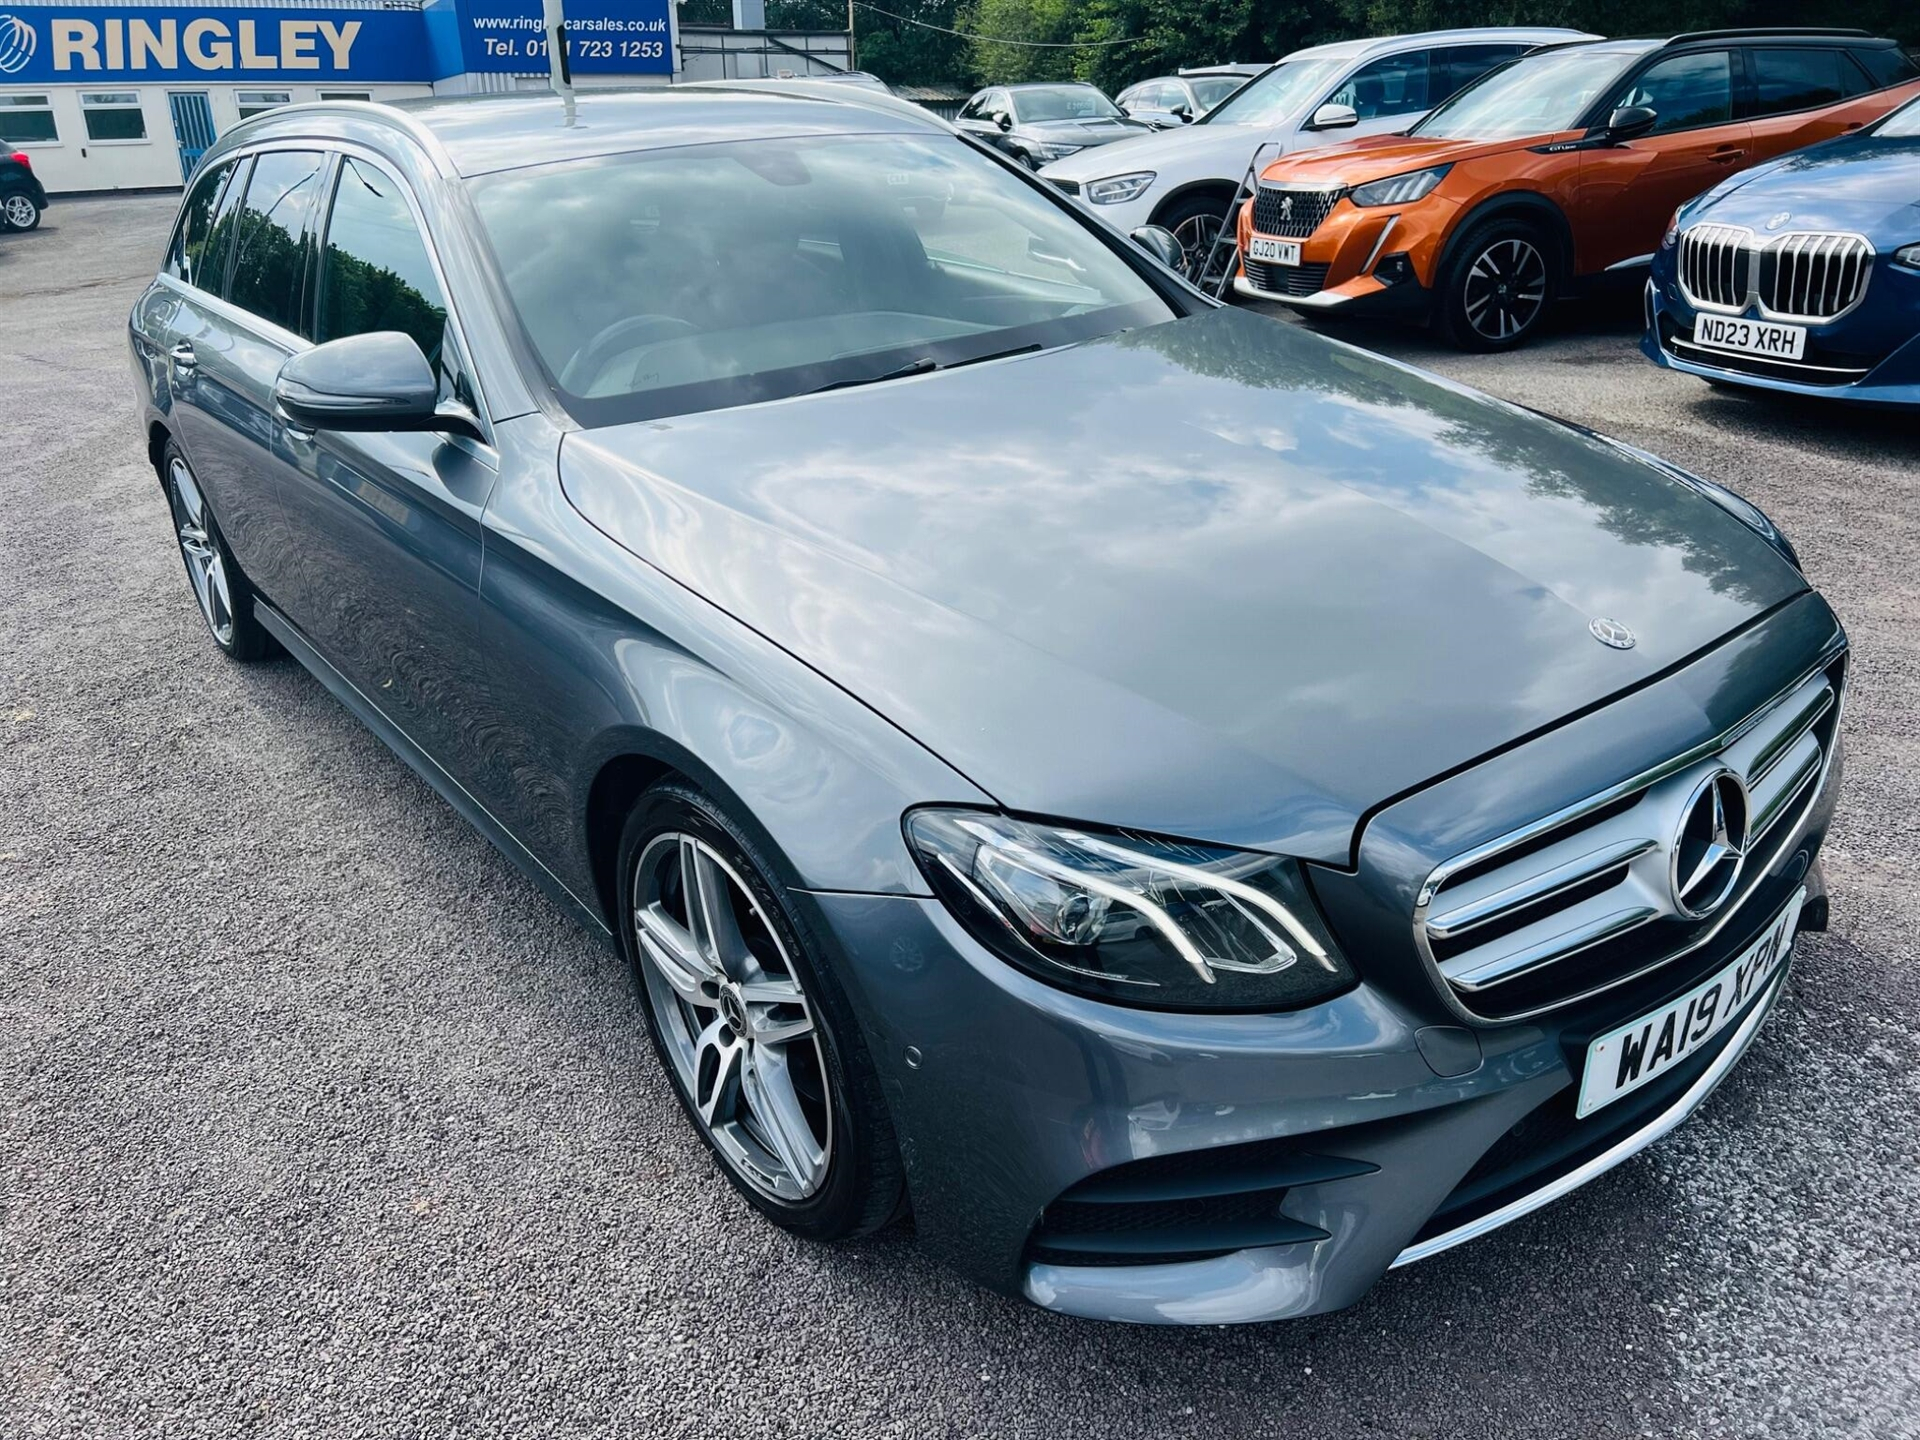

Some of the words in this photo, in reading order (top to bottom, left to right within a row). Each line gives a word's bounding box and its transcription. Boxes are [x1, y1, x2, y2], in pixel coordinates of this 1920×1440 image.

[51, 18, 362, 71] RINGLEY
[484, 39, 519, 56] Tel.
[526, 39, 570, 57] 011
[579, 40, 612, 58] 723
[621, 40, 663, 58] 1253
[1253, 240, 1275, 258] GJ20
[1701, 319, 1750, 346] ND23
[1754, 326, 1796, 354] XRH
[1615, 983, 1722, 1090] WA19
[1723, 912, 1790, 1019] XPN
